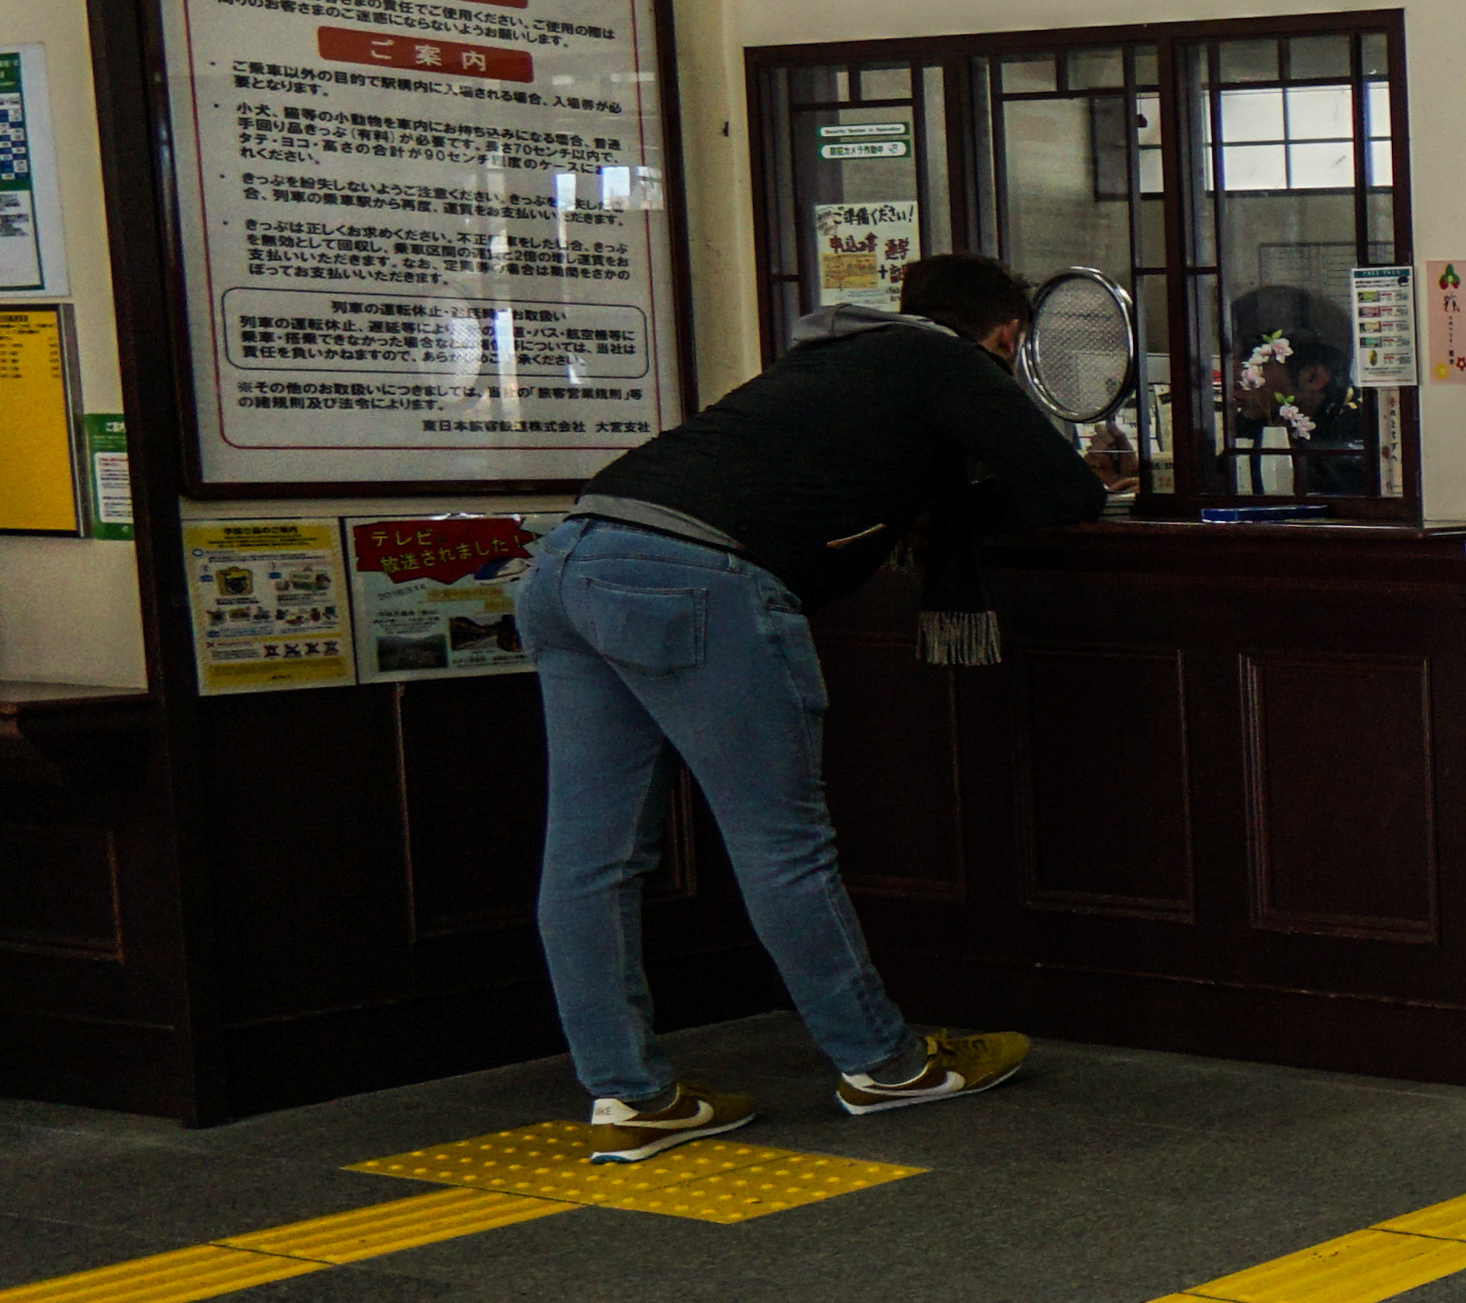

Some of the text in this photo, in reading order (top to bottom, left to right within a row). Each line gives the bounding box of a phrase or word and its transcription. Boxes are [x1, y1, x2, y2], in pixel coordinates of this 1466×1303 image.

[370, 38, 487, 73] ご案内
[371, 527, 433, 547] テレビ
